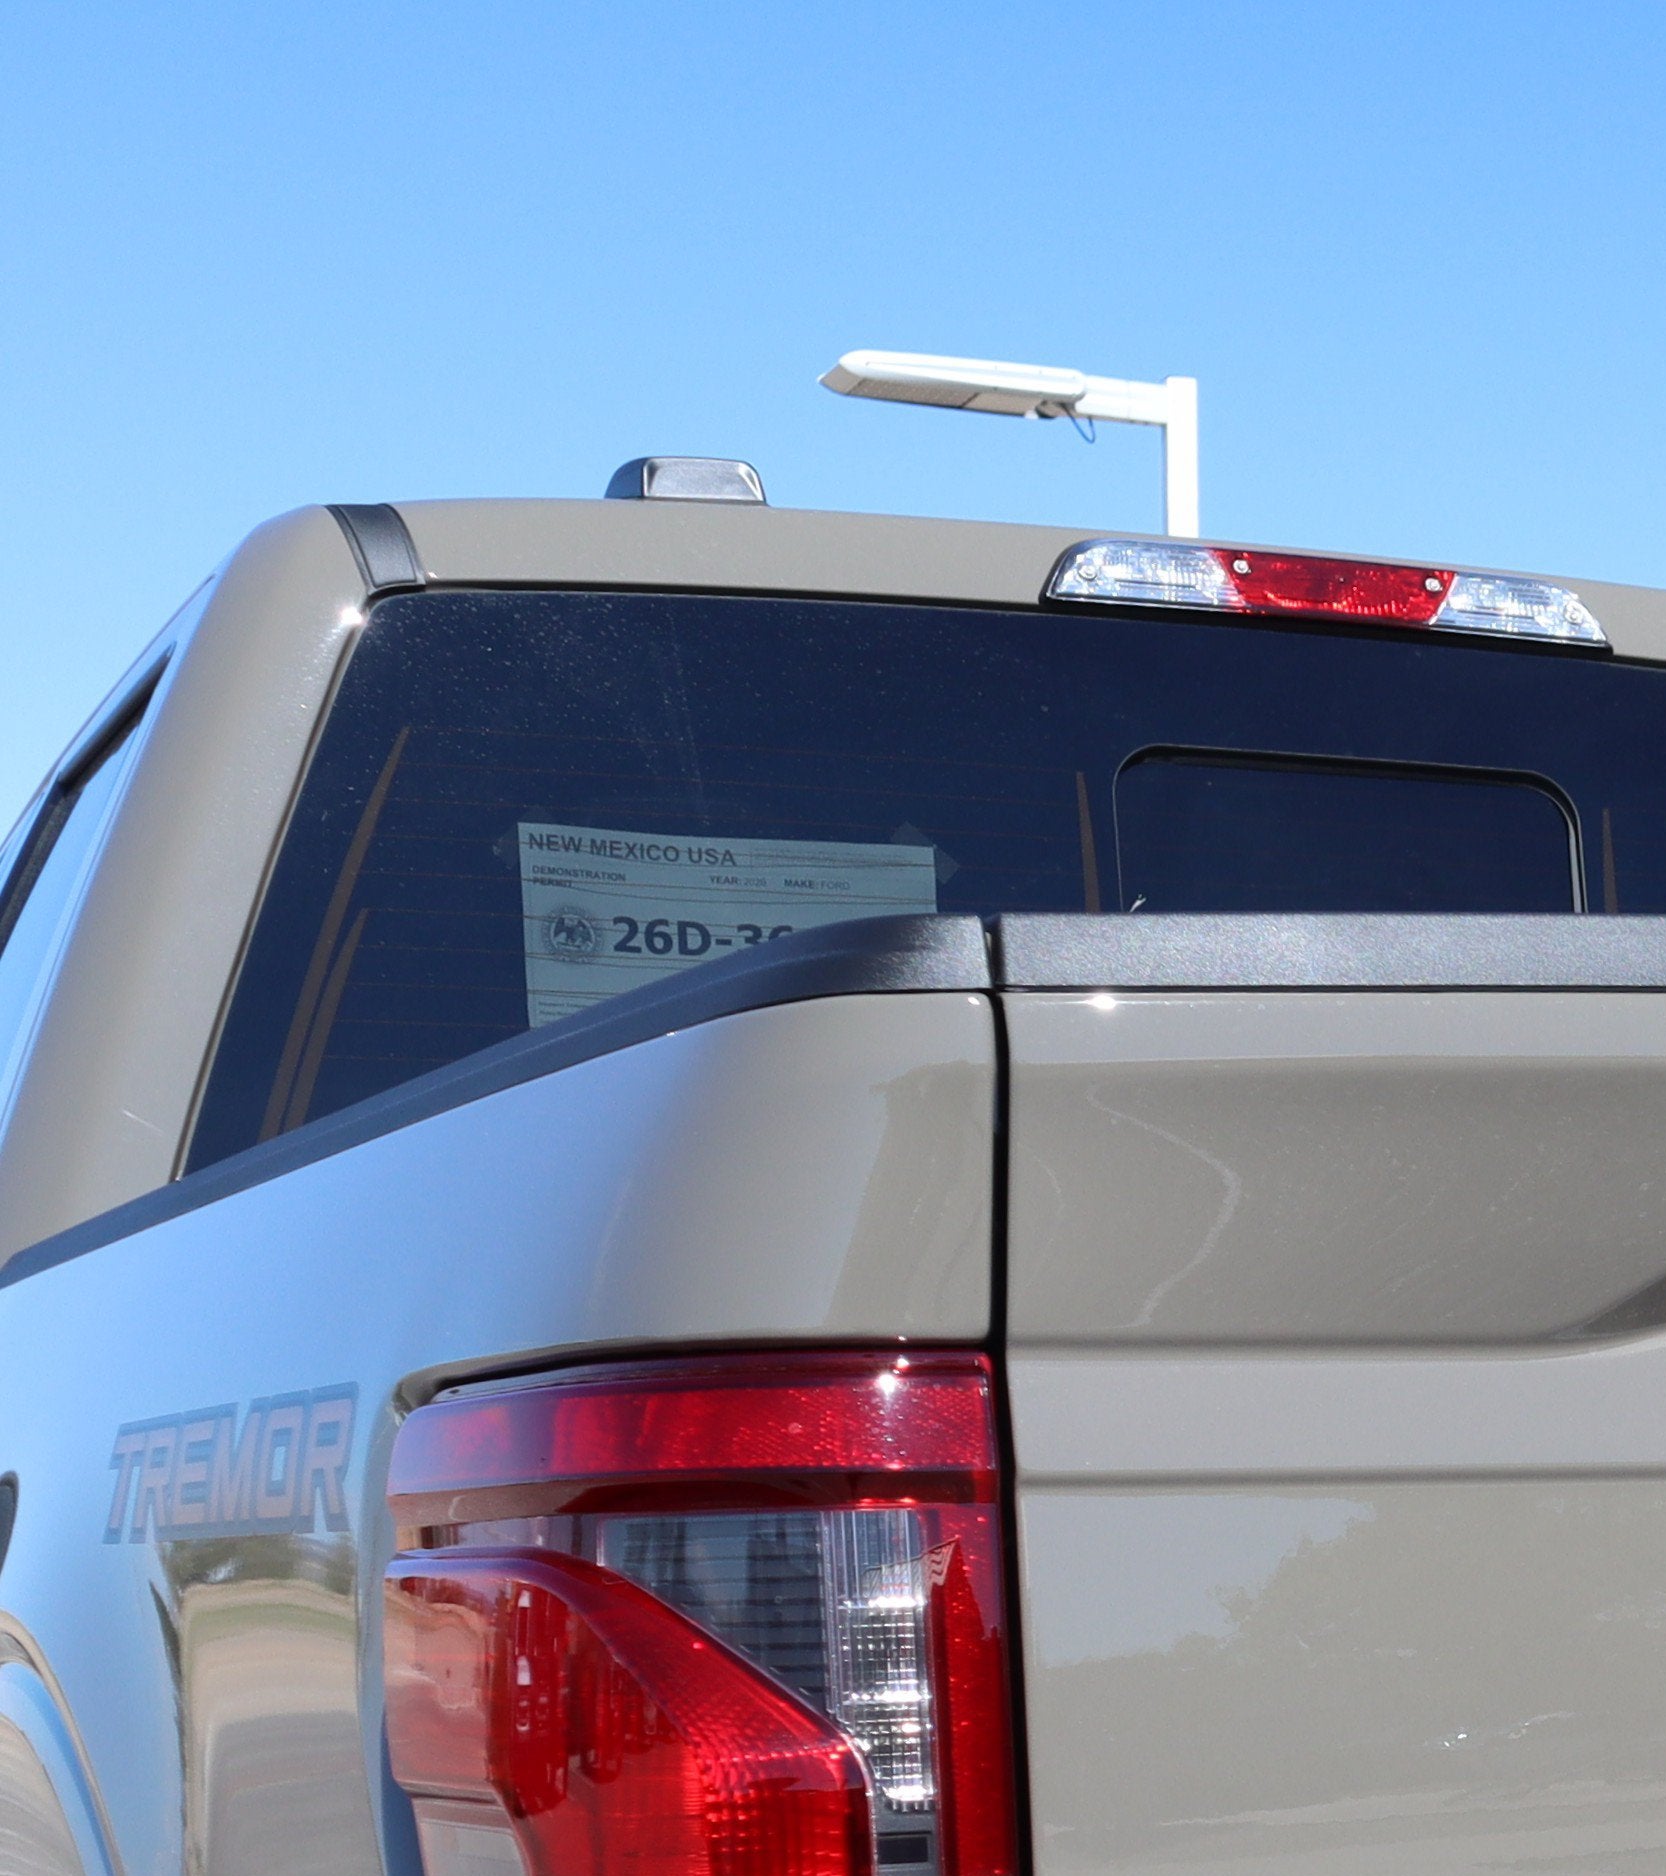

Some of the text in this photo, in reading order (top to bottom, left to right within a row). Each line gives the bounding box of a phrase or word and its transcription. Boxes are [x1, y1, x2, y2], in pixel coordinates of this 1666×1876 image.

[528, 832, 582, 854] NEW
[589, 838, 679, 862] MEXICO
[687, 847, 737, 867] USA
[531, 864, 626, 882] DEMONSTRATION
[709, 875, 742, 886] YEAR:
[783, 877, 851, 891] MAKE: FORD
[102, 1381, 359, 1545] TREMOR
